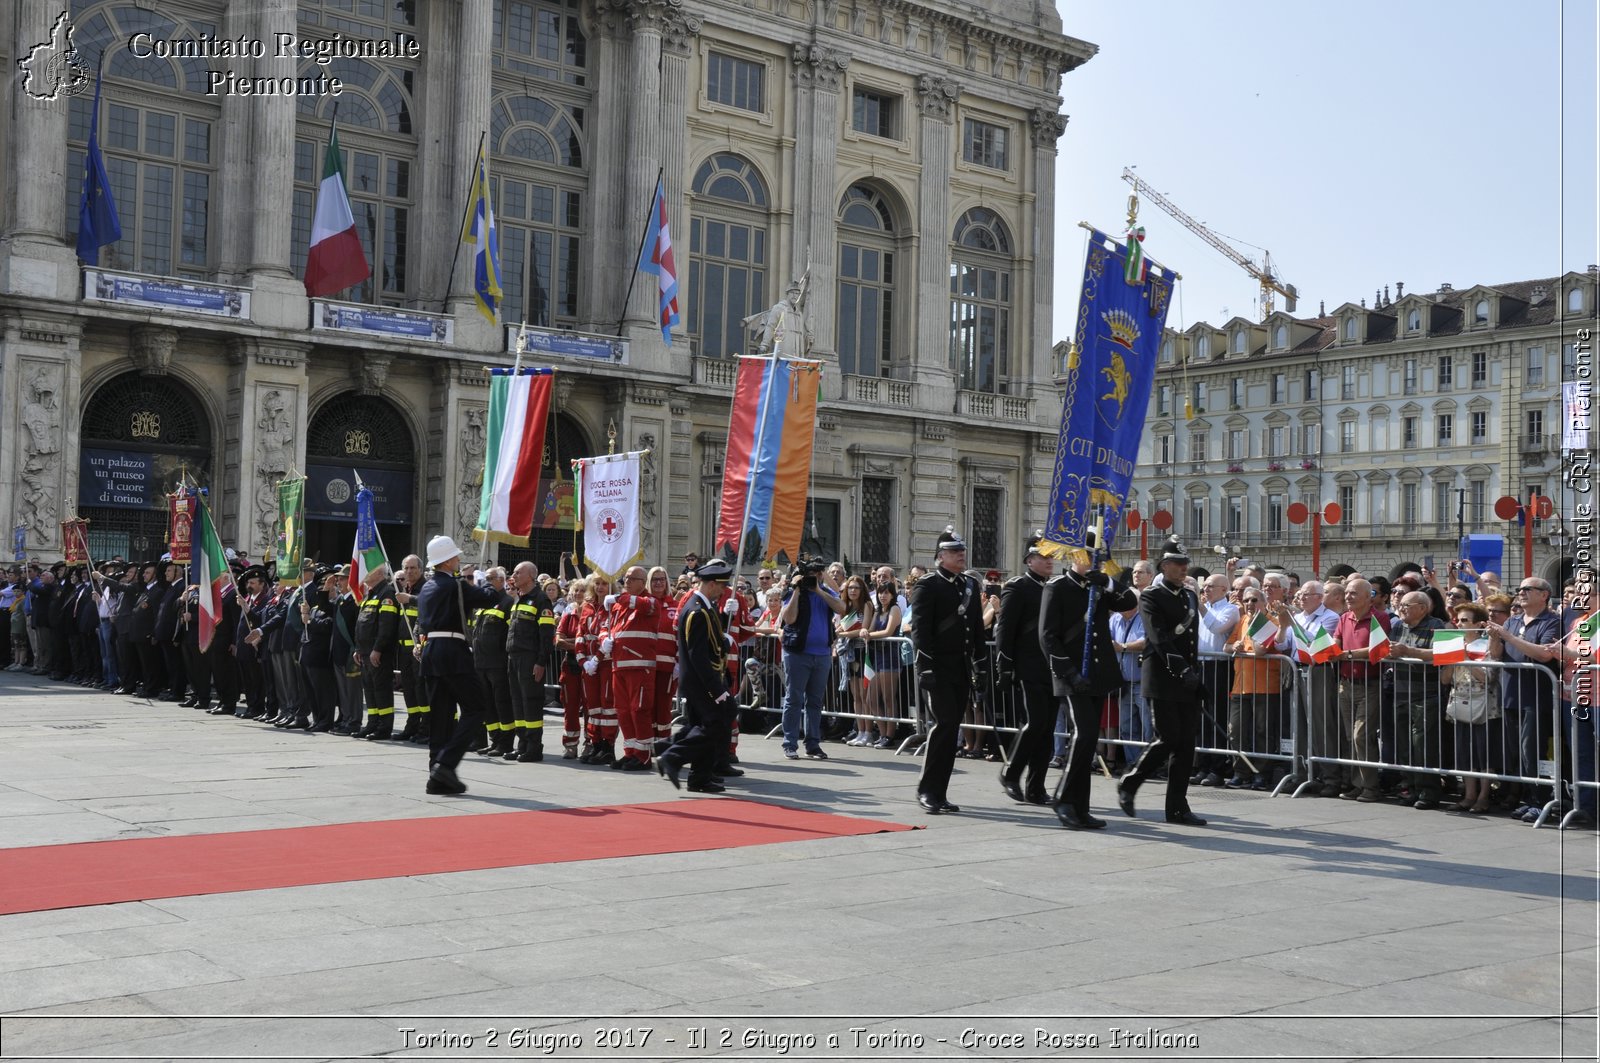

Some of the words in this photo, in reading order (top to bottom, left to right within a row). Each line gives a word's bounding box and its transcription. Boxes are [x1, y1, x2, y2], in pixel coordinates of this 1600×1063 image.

[90, 457, 105, 465] un
[108, 456, 145, 469] palazzo
[95, 470, 109, 478] un
[112, 471, 145, 480] museo
[107, 480, 114, 490] il
[116, 483, 145, 492] cuore
[609, 478, 633, 488] ROSSA
[99, 491, 110, 502] di
[113, 493, 143, 504] torino
